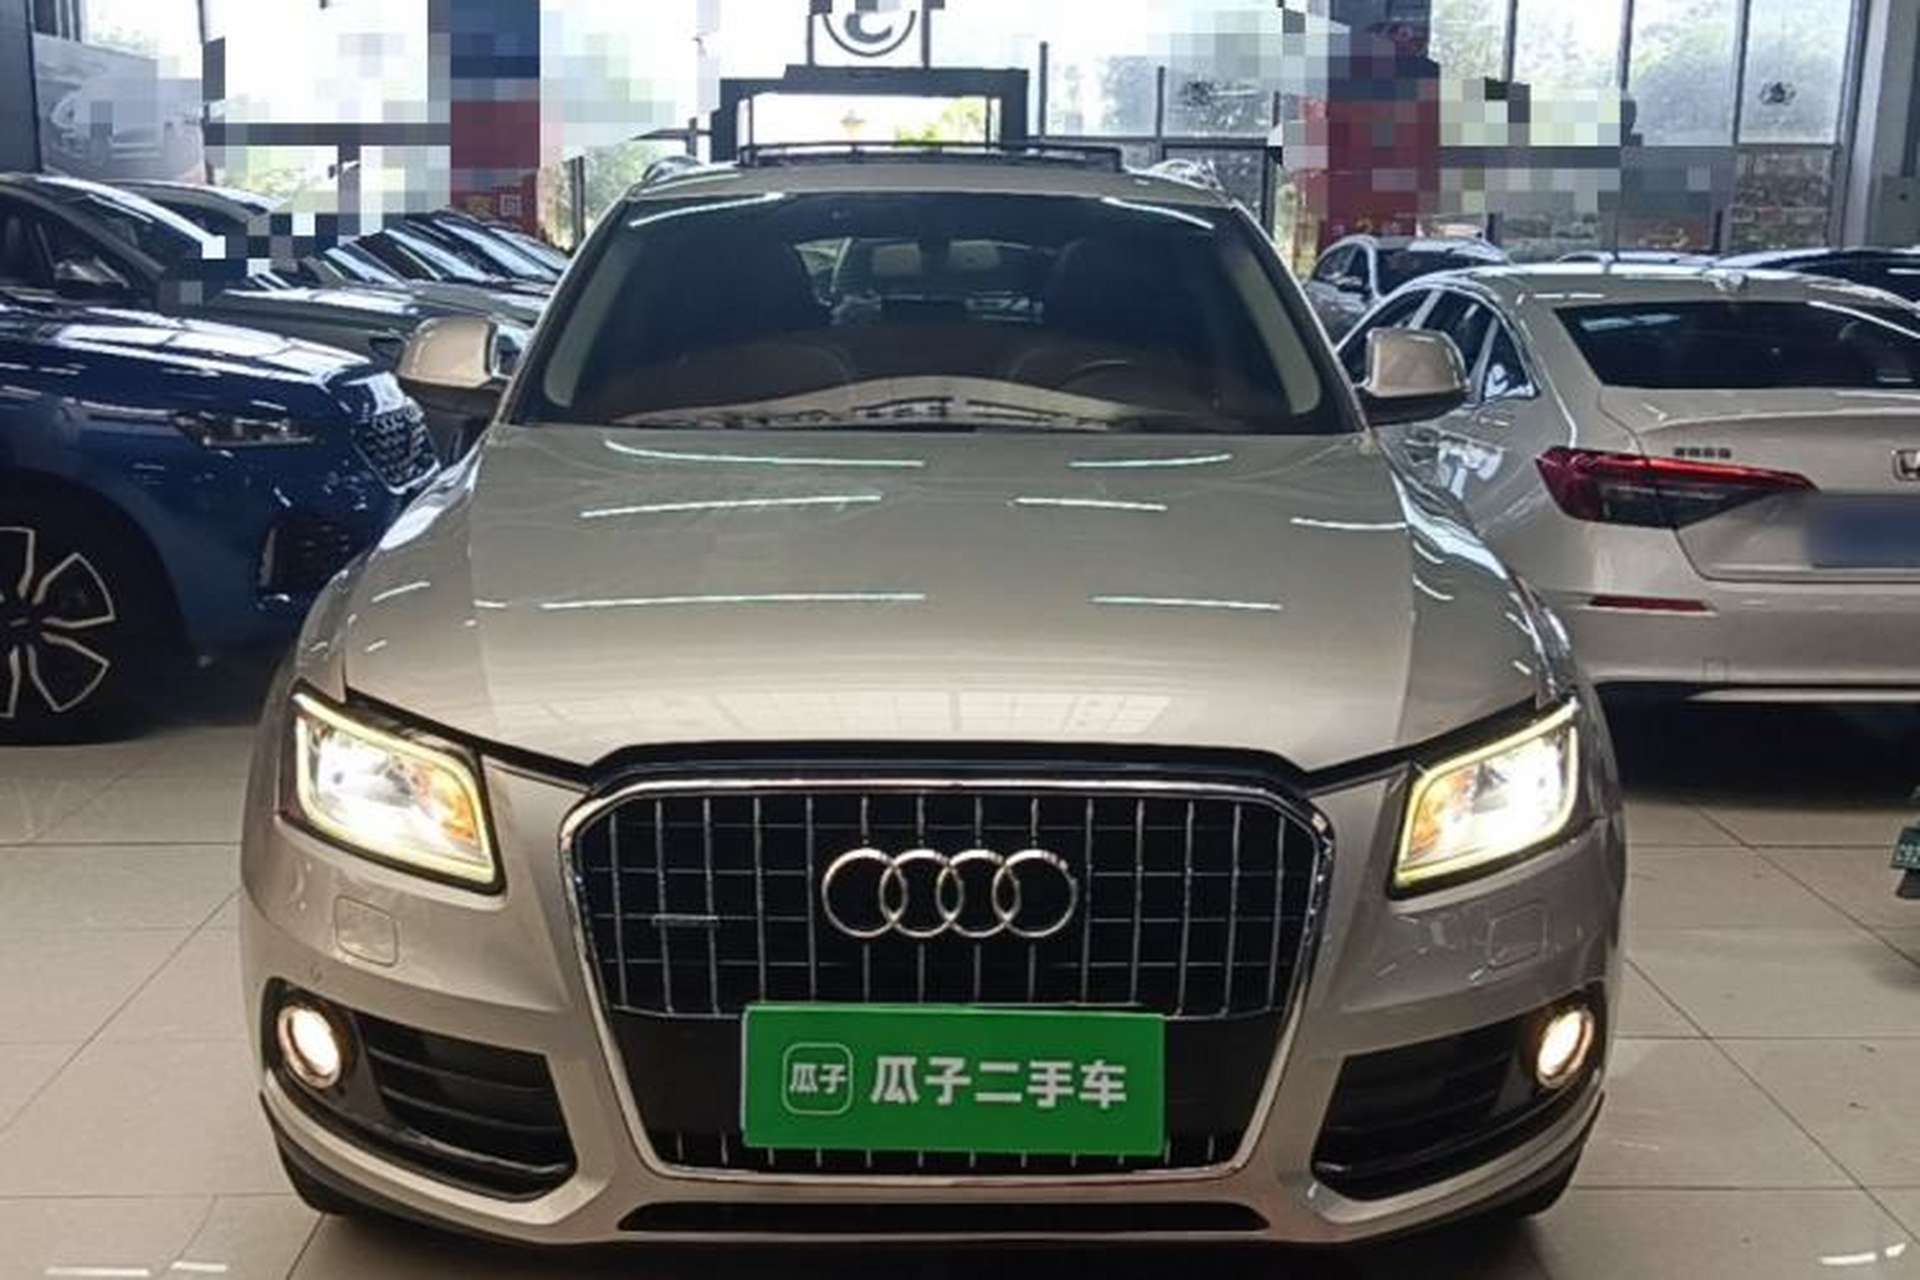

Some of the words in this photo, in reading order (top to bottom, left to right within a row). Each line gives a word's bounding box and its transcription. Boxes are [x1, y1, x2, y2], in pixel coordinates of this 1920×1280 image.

[789, 1063, 846, 1093] 瓜子
[871, 1055, 1127, 1108] 瓜子二手车
